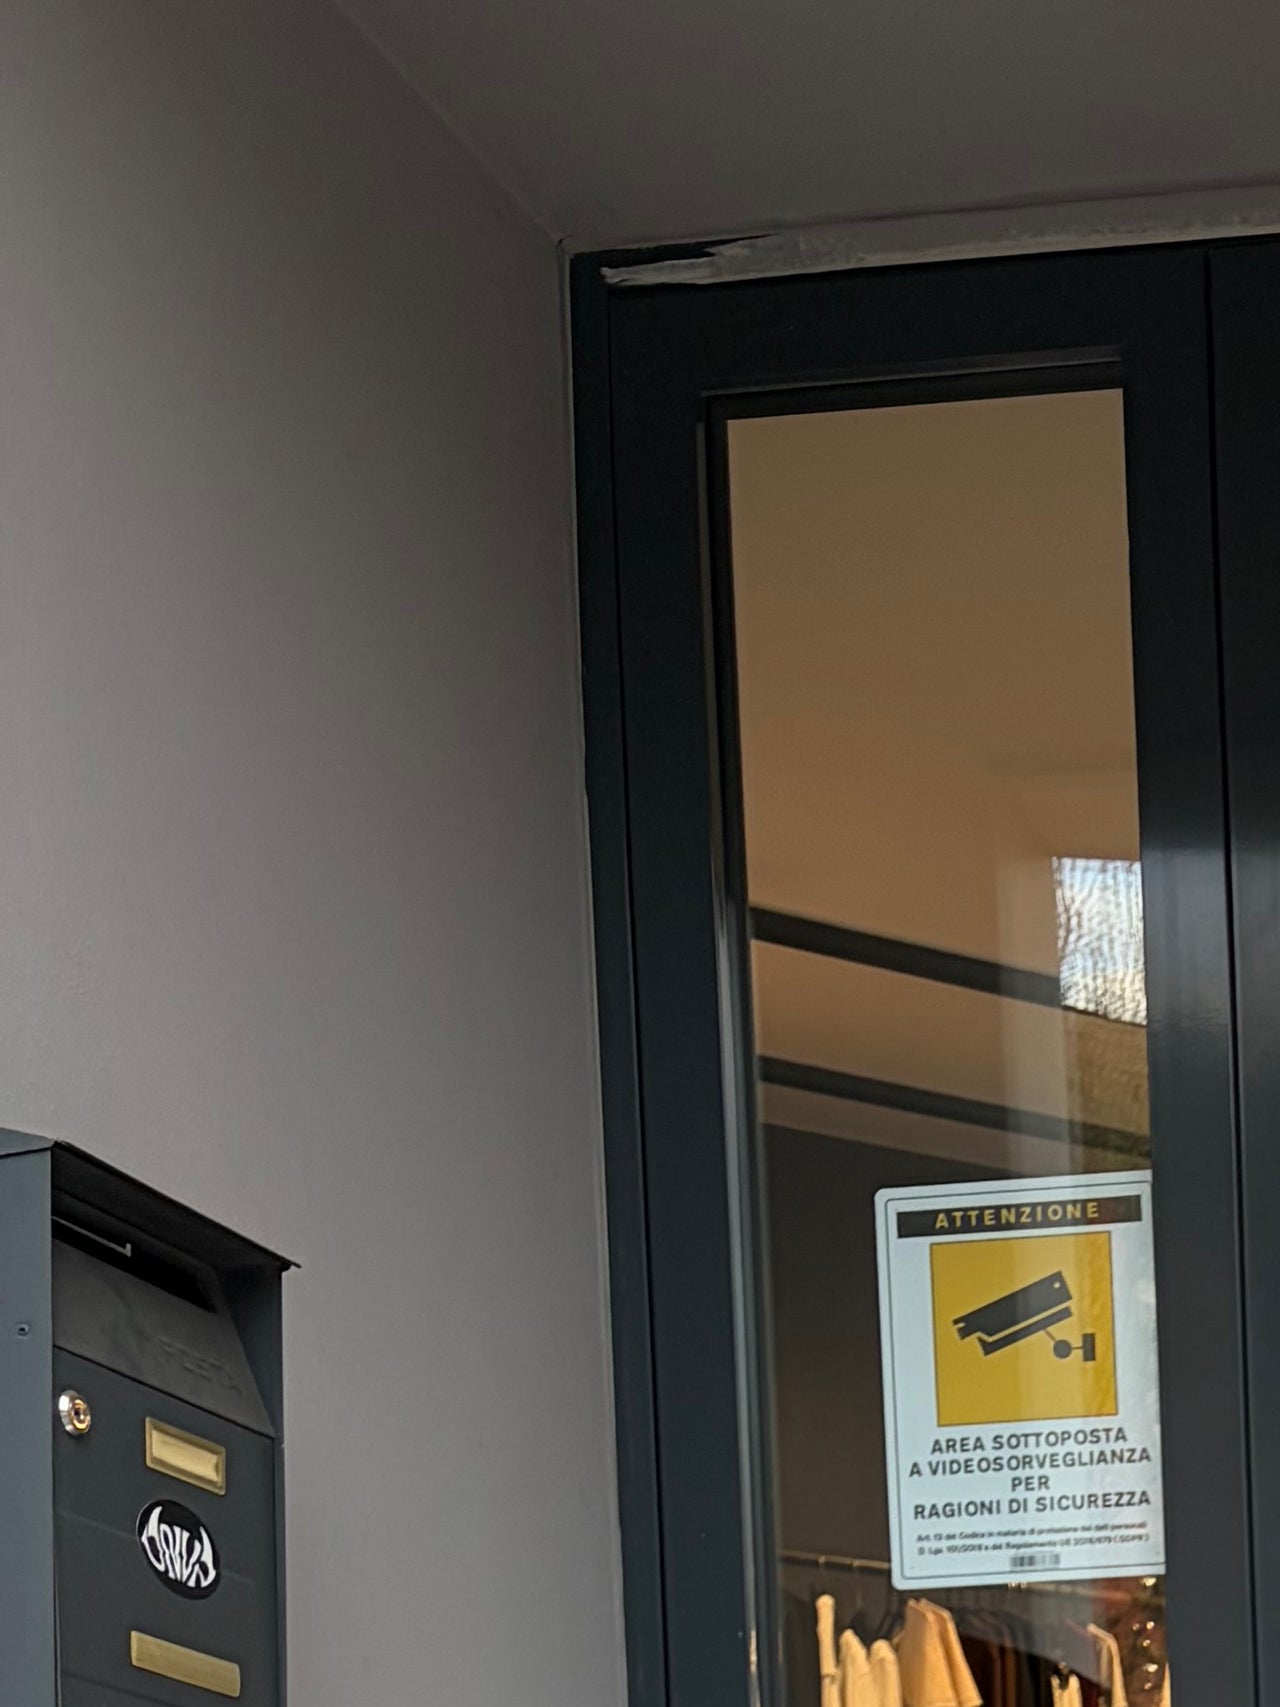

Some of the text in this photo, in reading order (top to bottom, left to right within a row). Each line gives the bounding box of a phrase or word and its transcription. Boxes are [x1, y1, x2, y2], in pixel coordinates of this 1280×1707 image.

[935, 1201, 1100, 1230] ATTENZIONE
[930, 1427, 1128, 1455] AREA SOTTOPOSTA
[909, 1447, 1152, 1478] A VIDEOSORVEGLIANZA
[1011, 1475, 1050, 1492] PER
[913, 1490, 1151, 1520] RAGIONI DI SICUREZZA
